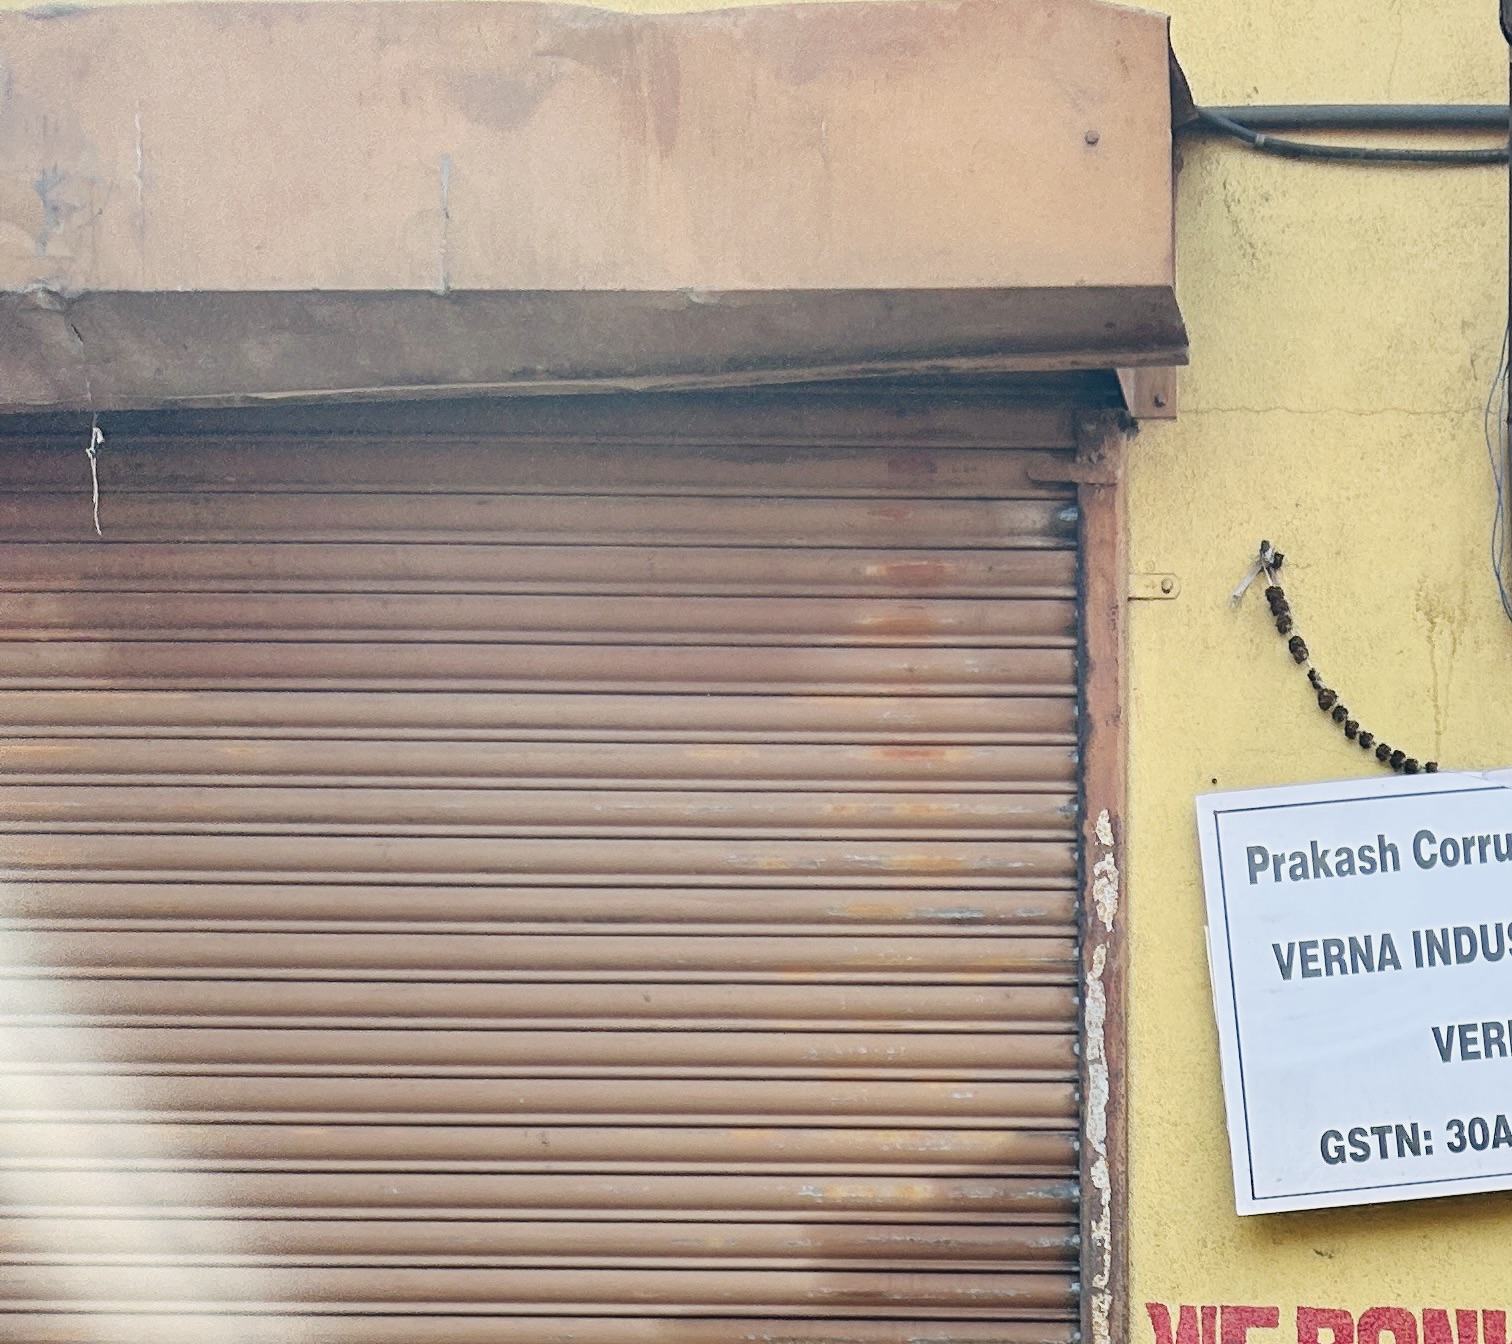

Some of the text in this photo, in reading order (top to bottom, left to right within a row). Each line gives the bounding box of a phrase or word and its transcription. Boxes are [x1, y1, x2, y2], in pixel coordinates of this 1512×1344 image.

[1246, 833, 1401, 885] Prakash
[1272, 933, 1402, 981] VERNA
[1320, 1122, 1435, 1165] GSTN:
